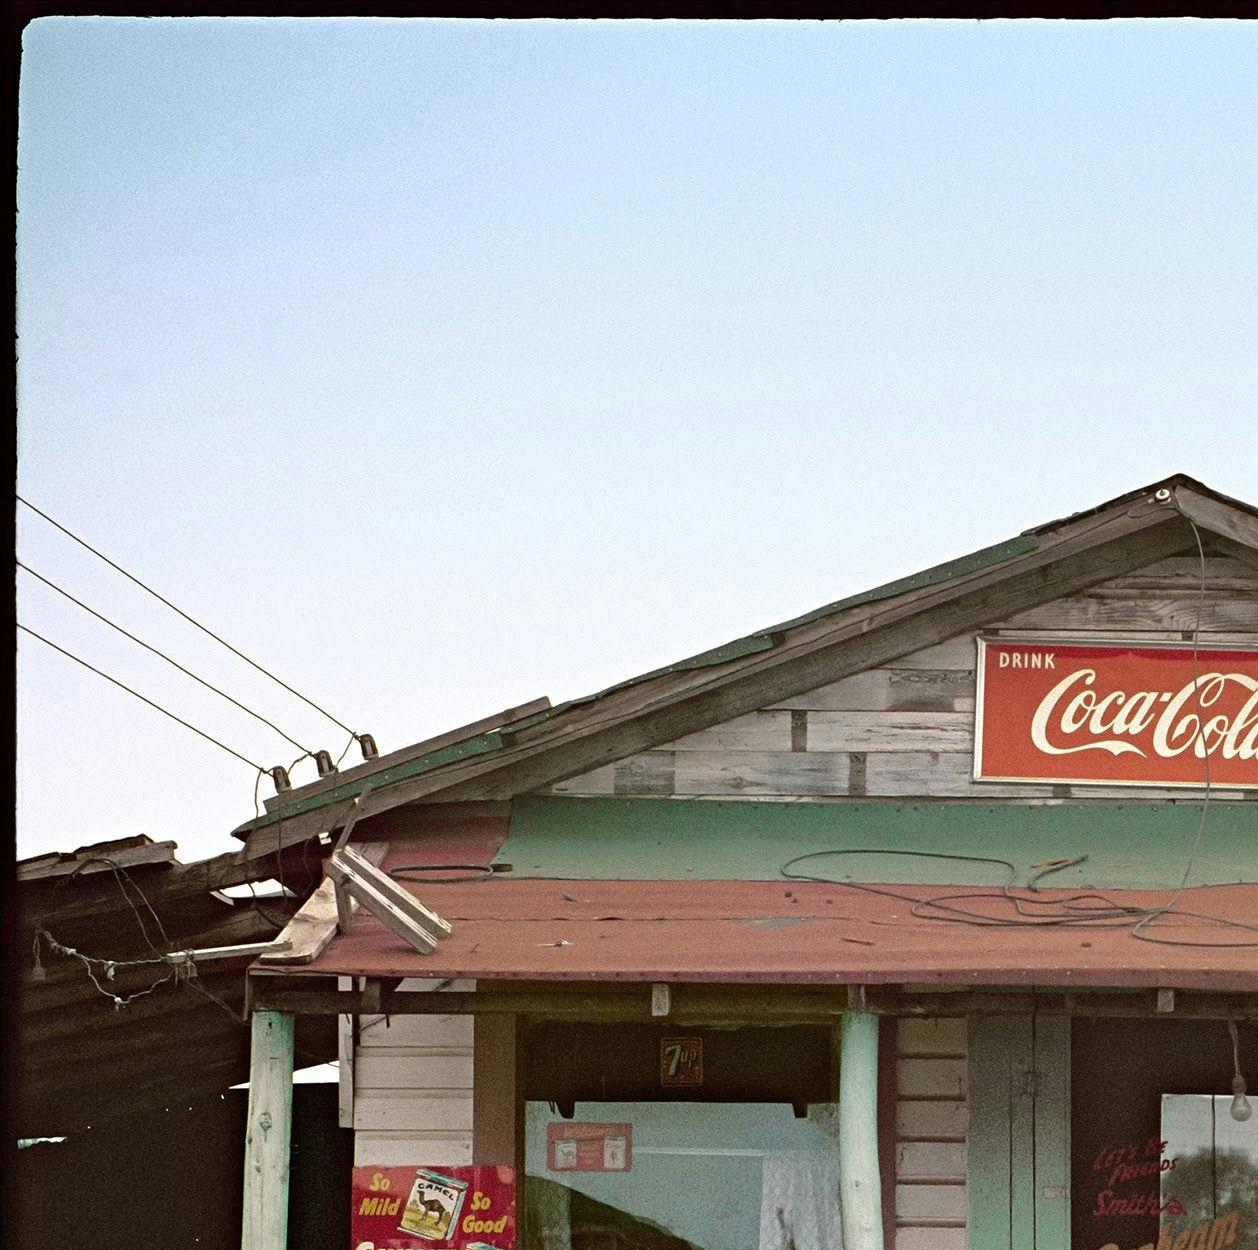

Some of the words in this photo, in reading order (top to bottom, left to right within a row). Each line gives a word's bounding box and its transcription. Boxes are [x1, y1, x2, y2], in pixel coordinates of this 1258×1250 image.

[1000, 652, 1056, 670] DRINK
[369, 1172, 391, 1192] So
[418, 1182, 455, 1201] CAMEL
[358, 1197, 401, 1216] Mild
[470, 1191, 491, 1211] So
[462, 1214, 508, 1234] Good
